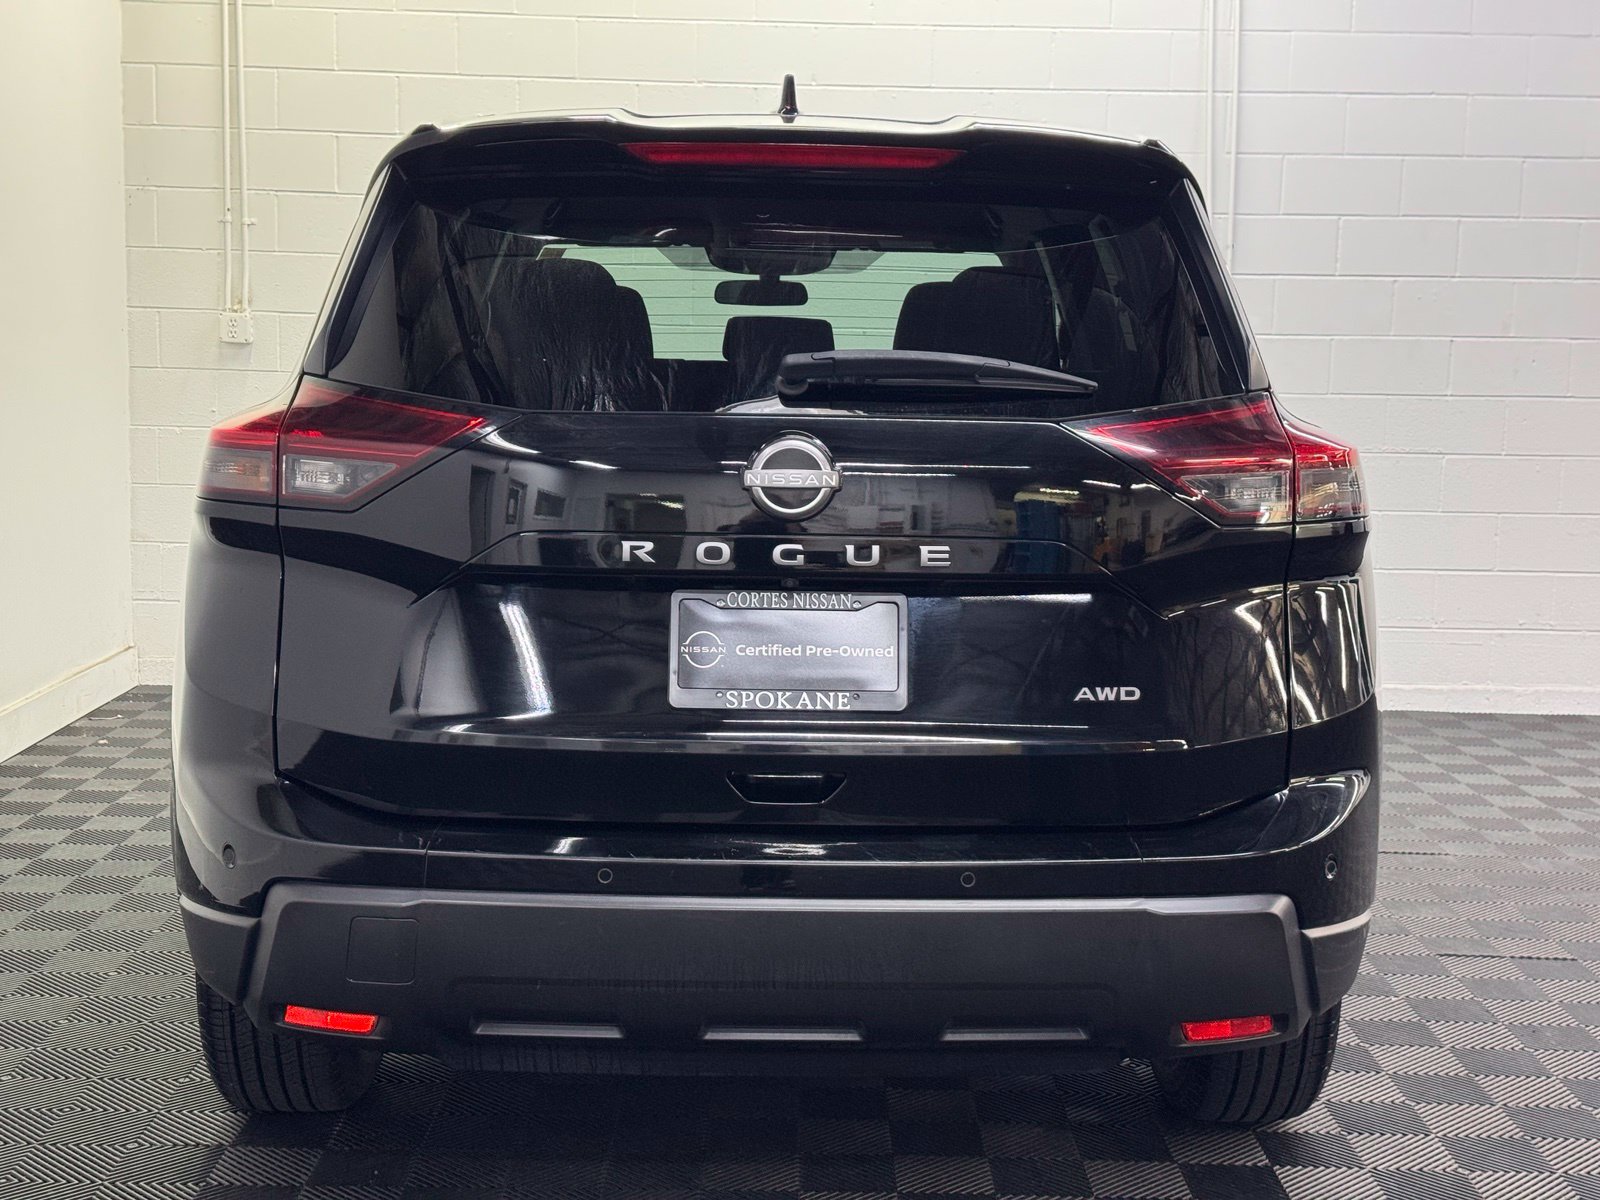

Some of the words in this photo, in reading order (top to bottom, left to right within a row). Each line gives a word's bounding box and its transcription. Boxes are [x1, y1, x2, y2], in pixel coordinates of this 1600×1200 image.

[746, 472, 838, 486] NISSAN
[621, 540, 952, 567] ROGUE
[726, 592, 789, 609] CORTES
[792, 592, 853, 610] NISSAN
[680, 645, 727, 654] NISSAN
[735, 643, 801, 658] Certified
[806, 644, 895, 658] Pre-Owned
[725, 691, 851, 711] SPOKANE
[1073, 686, 1142, 703] AWD
